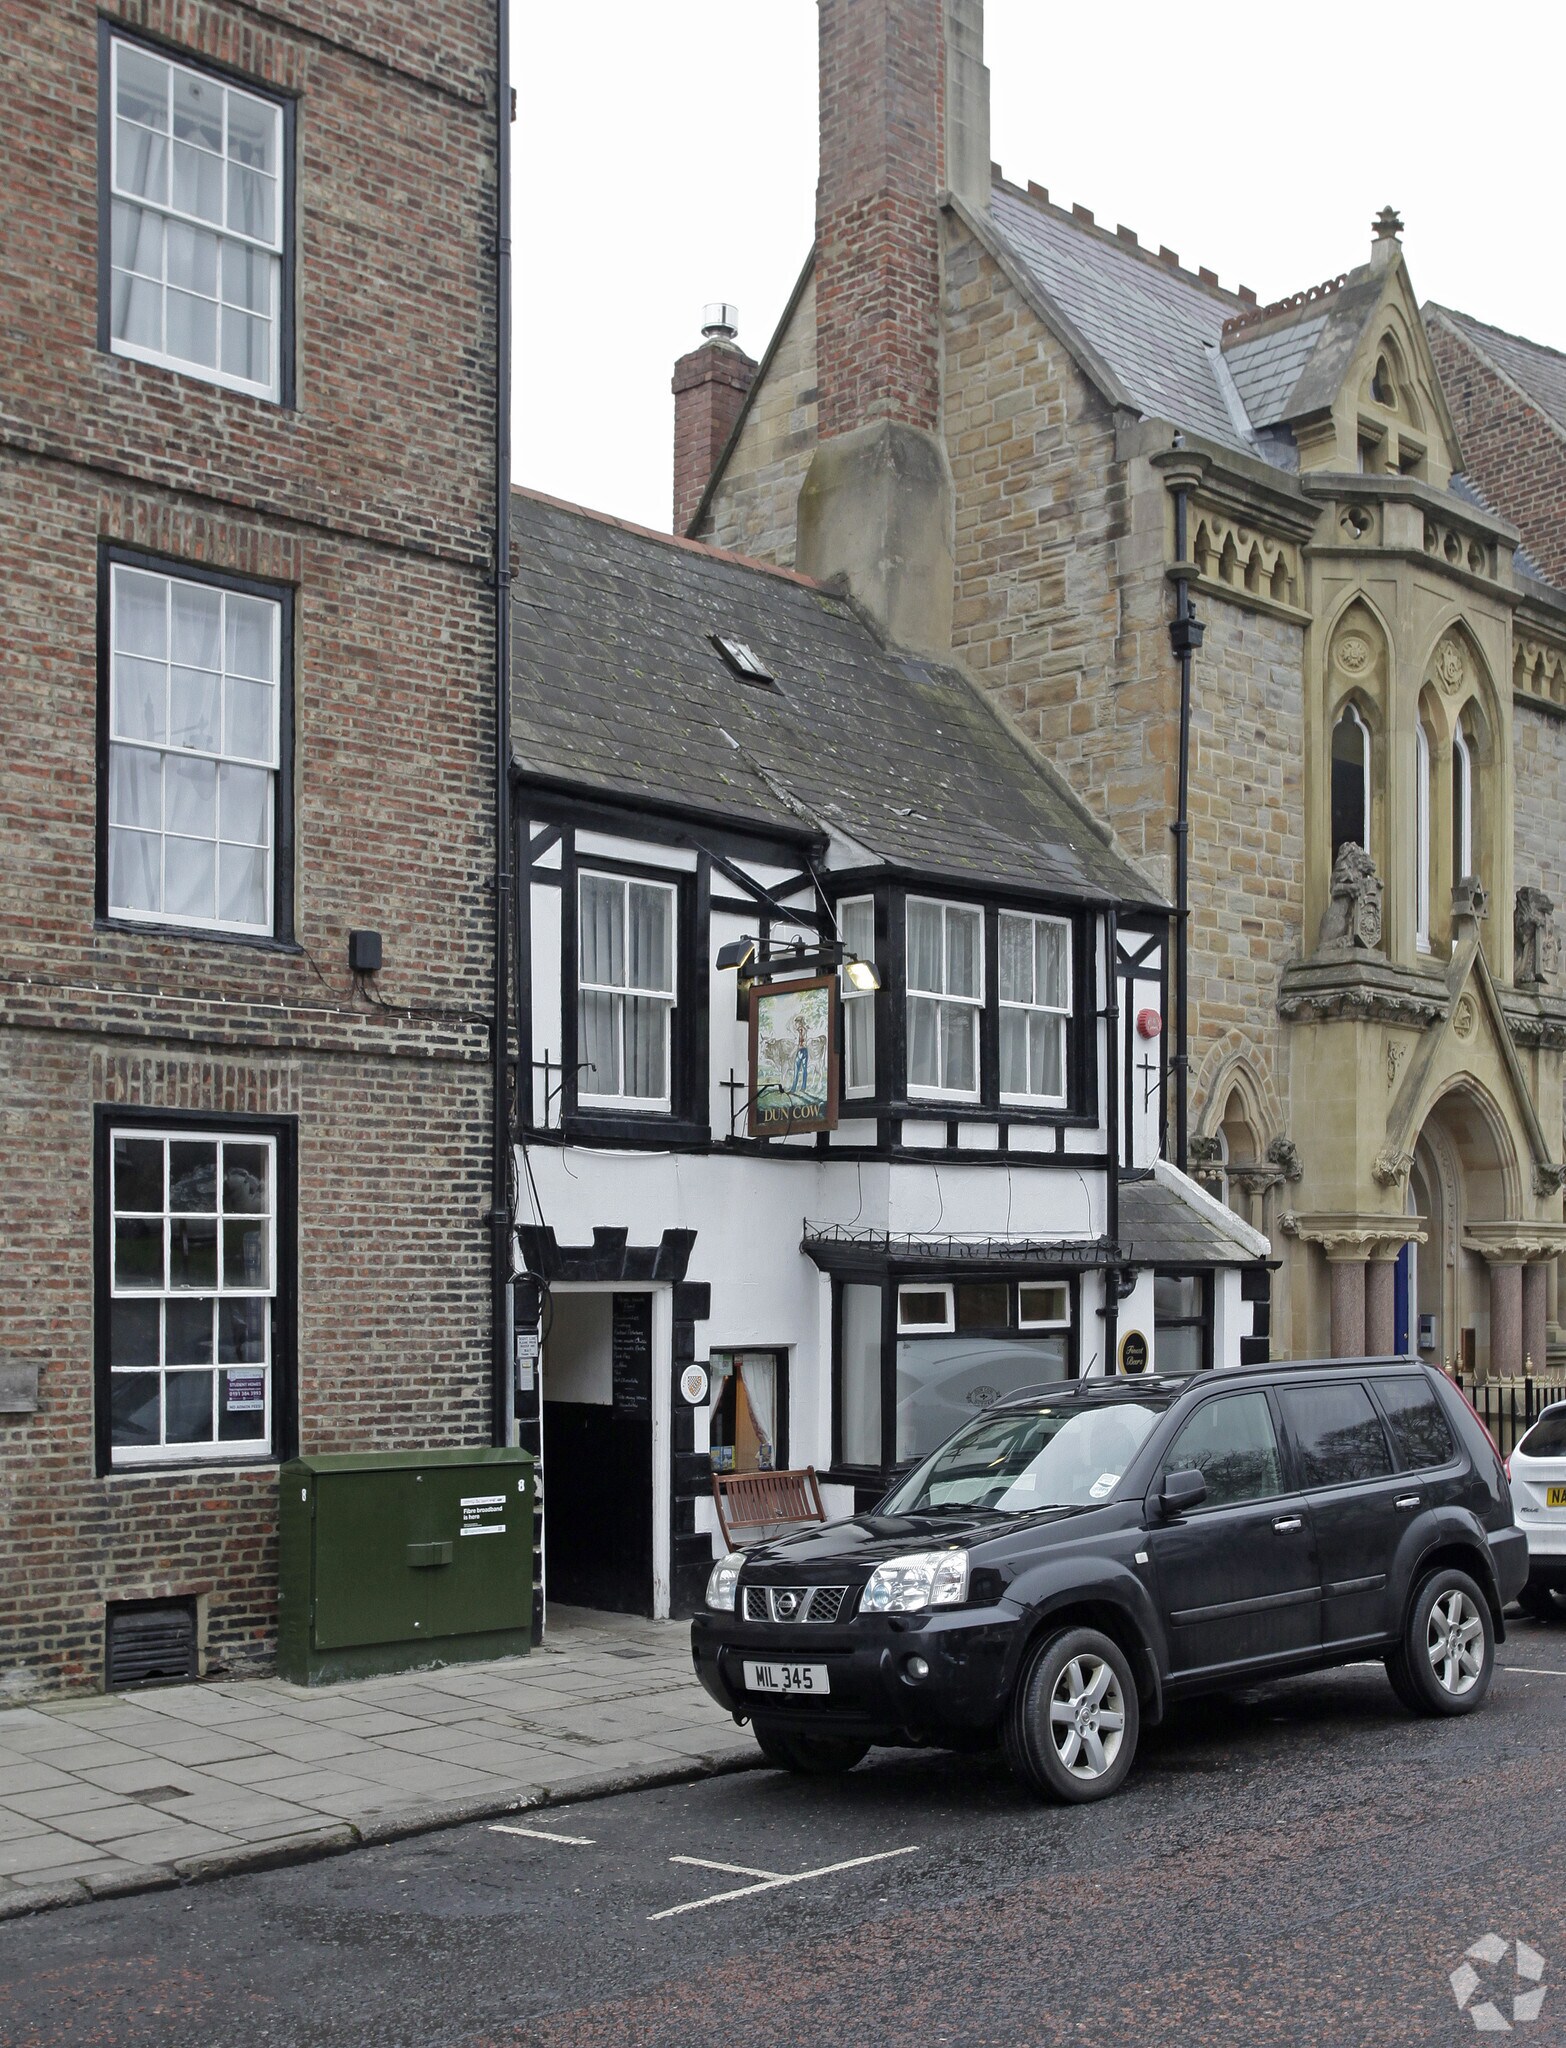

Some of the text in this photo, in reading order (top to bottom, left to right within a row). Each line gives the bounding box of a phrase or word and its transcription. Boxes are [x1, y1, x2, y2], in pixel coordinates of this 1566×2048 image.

[765, 1105, 820, 1121] DUN COW
[1126, 1345, 1144, 1355] Finest
[1126, 1356, 1143, 1365] Beers
[518, 1479, 525, 1492] 8
[755, 1665, 813, 1689] MIL 345
